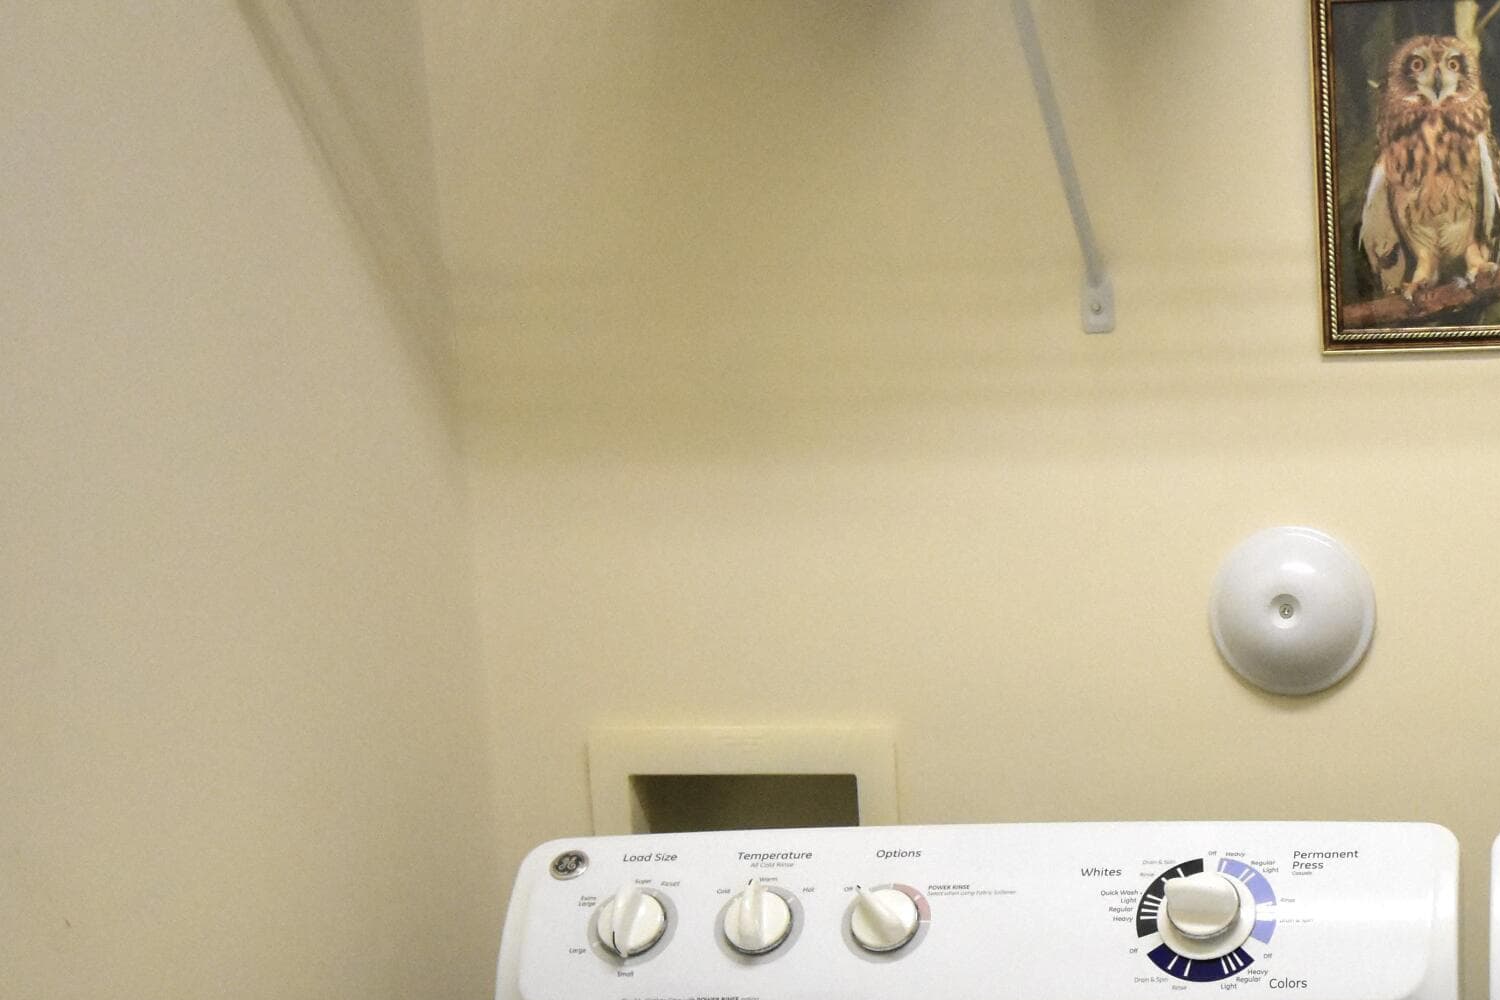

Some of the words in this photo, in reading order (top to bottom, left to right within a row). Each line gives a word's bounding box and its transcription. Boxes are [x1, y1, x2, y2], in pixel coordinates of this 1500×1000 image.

[623, 853, 652, 862] Load
[655, 852, 678, 861] Size
[737, 851, 813, 861] Temperature
[876, 850, 922, 859] Options
[1293, 850, 1359, 859] Permanent
[1292, 861, 1324, 870] Press
[1081, 867, 1122, 876] Whites
[1101, 889, 1118, 897] Quick
[1247, 968, 1268, 976] Heavy
[1236, 976, 1261, 984] Regular
[1269, 978, 1308, 989] Colors
[1220, 983, 1237, 991] Light
